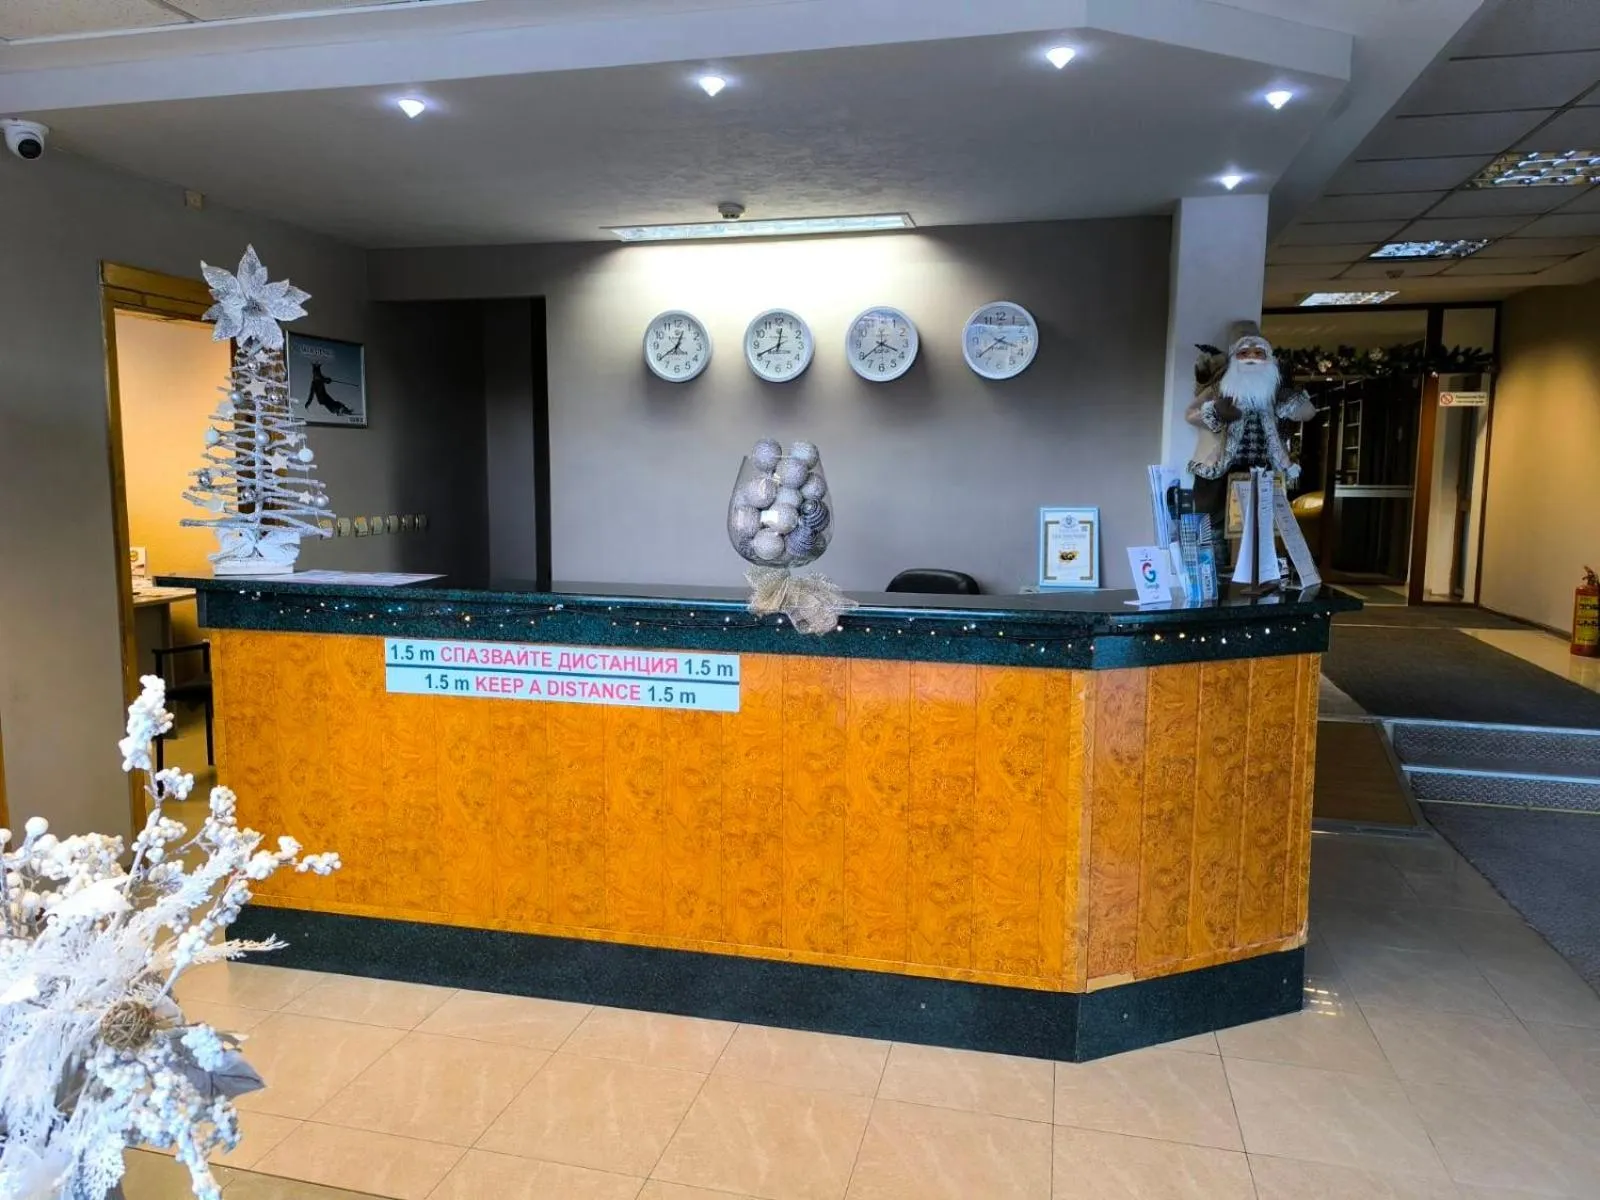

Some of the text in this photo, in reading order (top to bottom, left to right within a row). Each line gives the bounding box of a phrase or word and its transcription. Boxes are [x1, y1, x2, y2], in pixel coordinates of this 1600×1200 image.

[984, 316, 993, 325] 11
[995, 311, 1007, 321] 12
[674, 319, 683, 328] 12
[655, 330, 665, 340] 10
[693, 331, 700, 341] 2
[755, 328, 766, 339] 10
[795, 329, 802, 340] 2
[899, 327, 906, 337] 2
[902, 339, 909, 348] 3
[972, 336, 979, 346] 9
[1021, 335, 1029, 344] 3
[653, 341, 660, 350] 9
[695, 343, 702, 352] 3
[753, 340, 760, 350] 9
[798, 341, 805, 351] 3
[794, 353, 800, 361] 4
[898, 351, 905, 359] 4
[1017, 347, 1024, 357] 4
[685, 360, 691, 370] 5
[765, 360, 771, 369] 7
[786, 360, 793, 370] 5
[867, 359, 874, 369] 7
[890, 359, 897, 368] 5
[1009, 356, 1016, 366] 5
[673, 364, 681, 373] 6
[775, 364, 782, 373] 6
[878, 363, 886, 372] 6
[1142, 562, 1157, 583] G
[390, 644, 734, 677] 1.5 m СПАЗВАЙТЕ ДИСТАНЦИЯ 1.5 m
[424, 673, 696, 704] 1.5 m KEEP A DISTANCE 1.5 m
